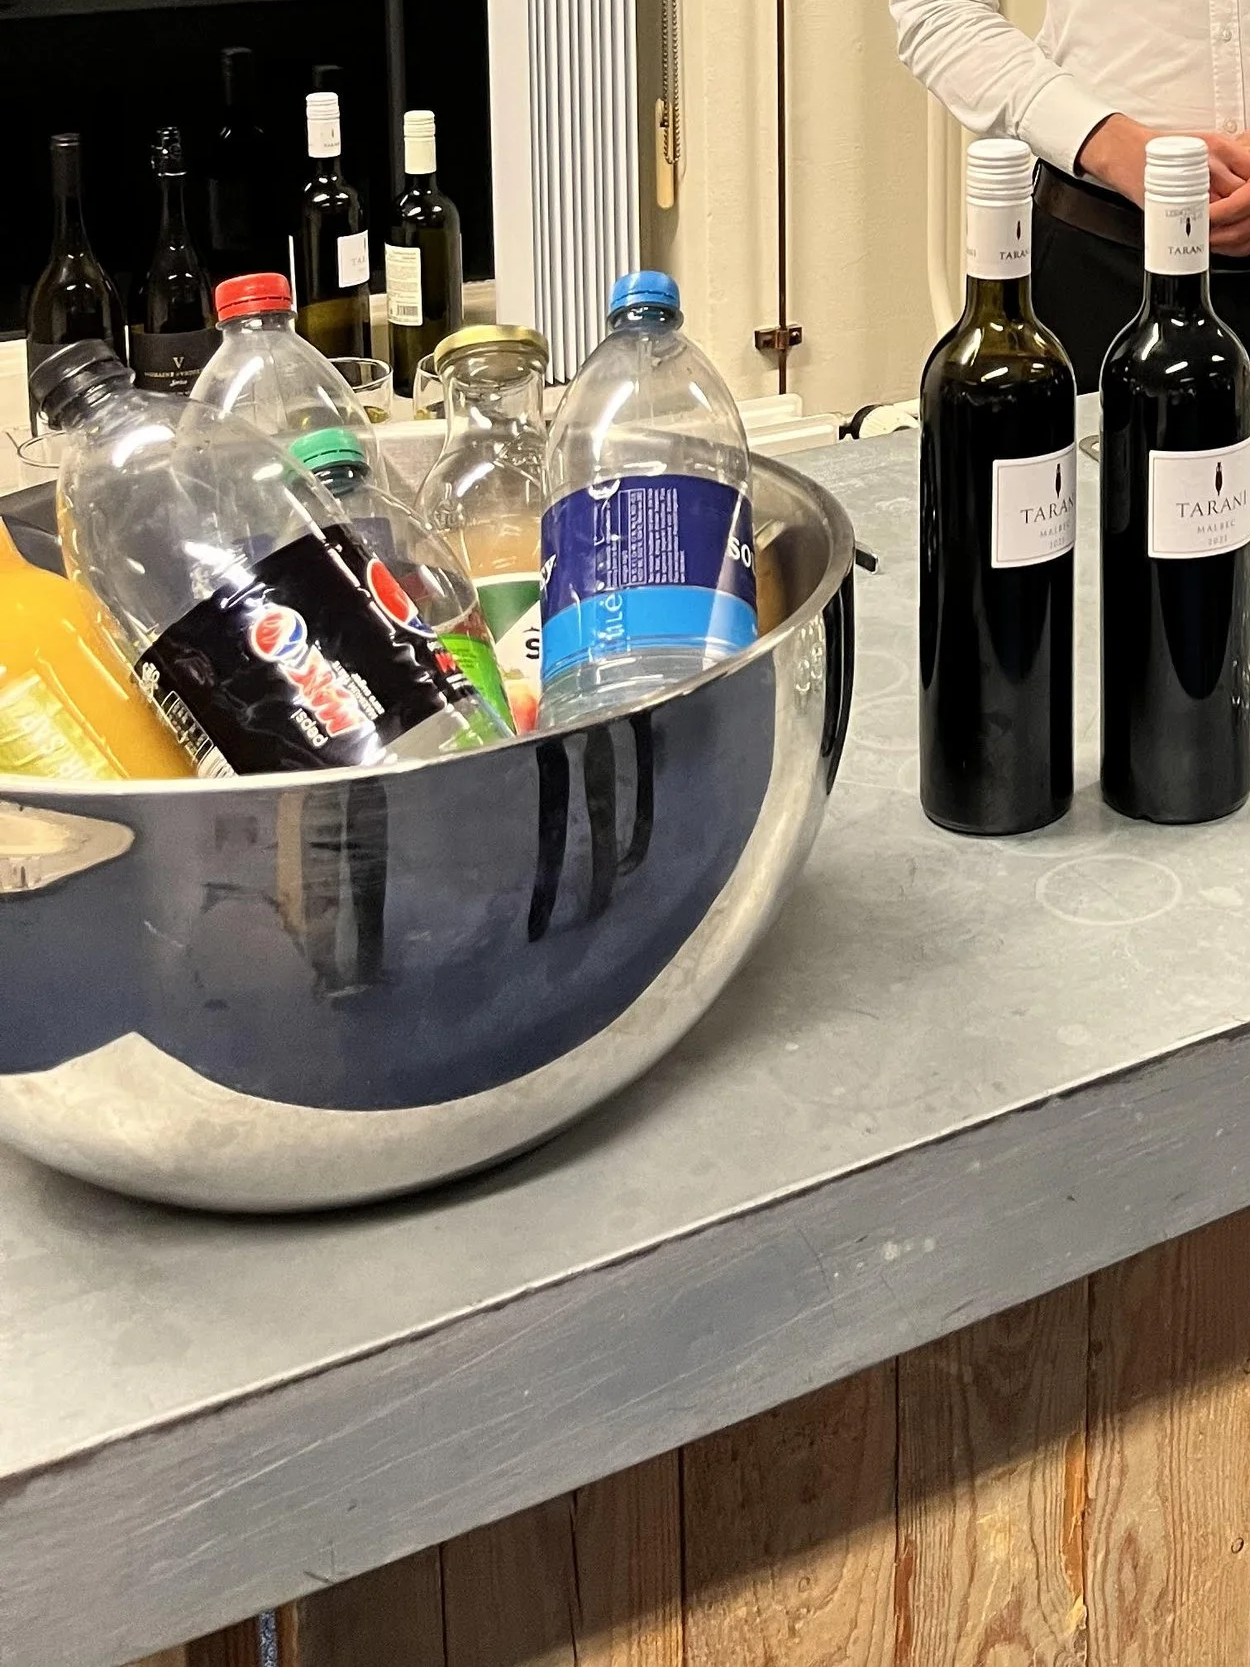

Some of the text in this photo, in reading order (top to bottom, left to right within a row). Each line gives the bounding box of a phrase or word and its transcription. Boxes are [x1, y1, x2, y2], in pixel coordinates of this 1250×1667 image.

[1175, 489, 1248, 519] TARANI
[1196, 518, 1236, 534] MALBEC
[728, 536, 754, 570] SO
[278, 645, 374, 737] MAX
[290, 708, 328, 747] pepsi
